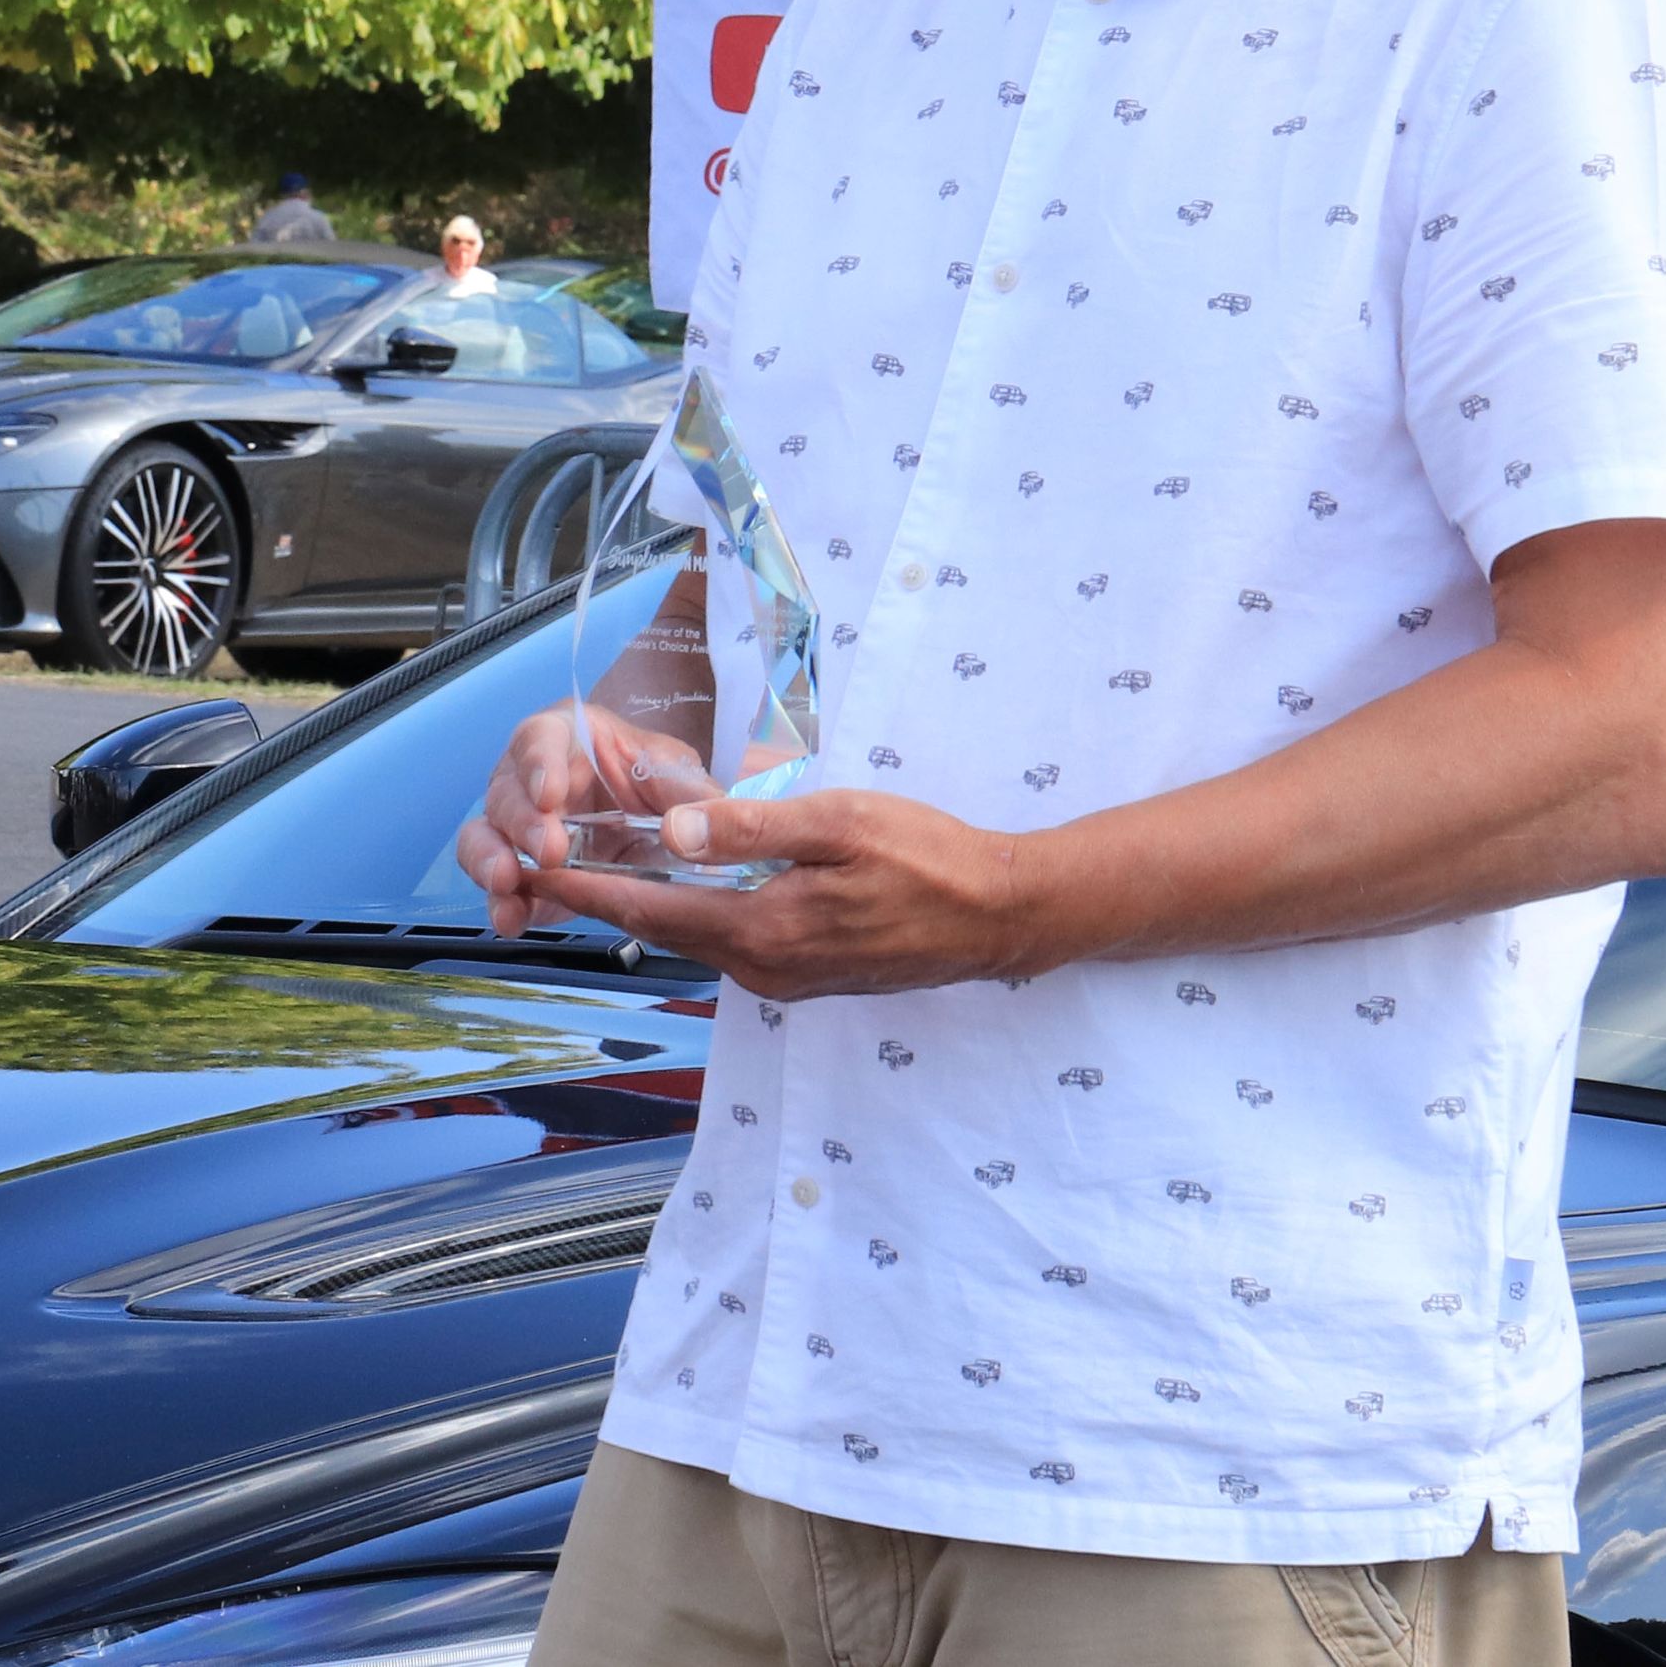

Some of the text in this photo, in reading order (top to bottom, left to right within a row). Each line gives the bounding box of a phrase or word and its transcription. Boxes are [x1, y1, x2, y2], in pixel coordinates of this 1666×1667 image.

[674, 627, 684, 638] of
[685, 628, 700, 639] the
[658, 640, 689, 653] Choice
